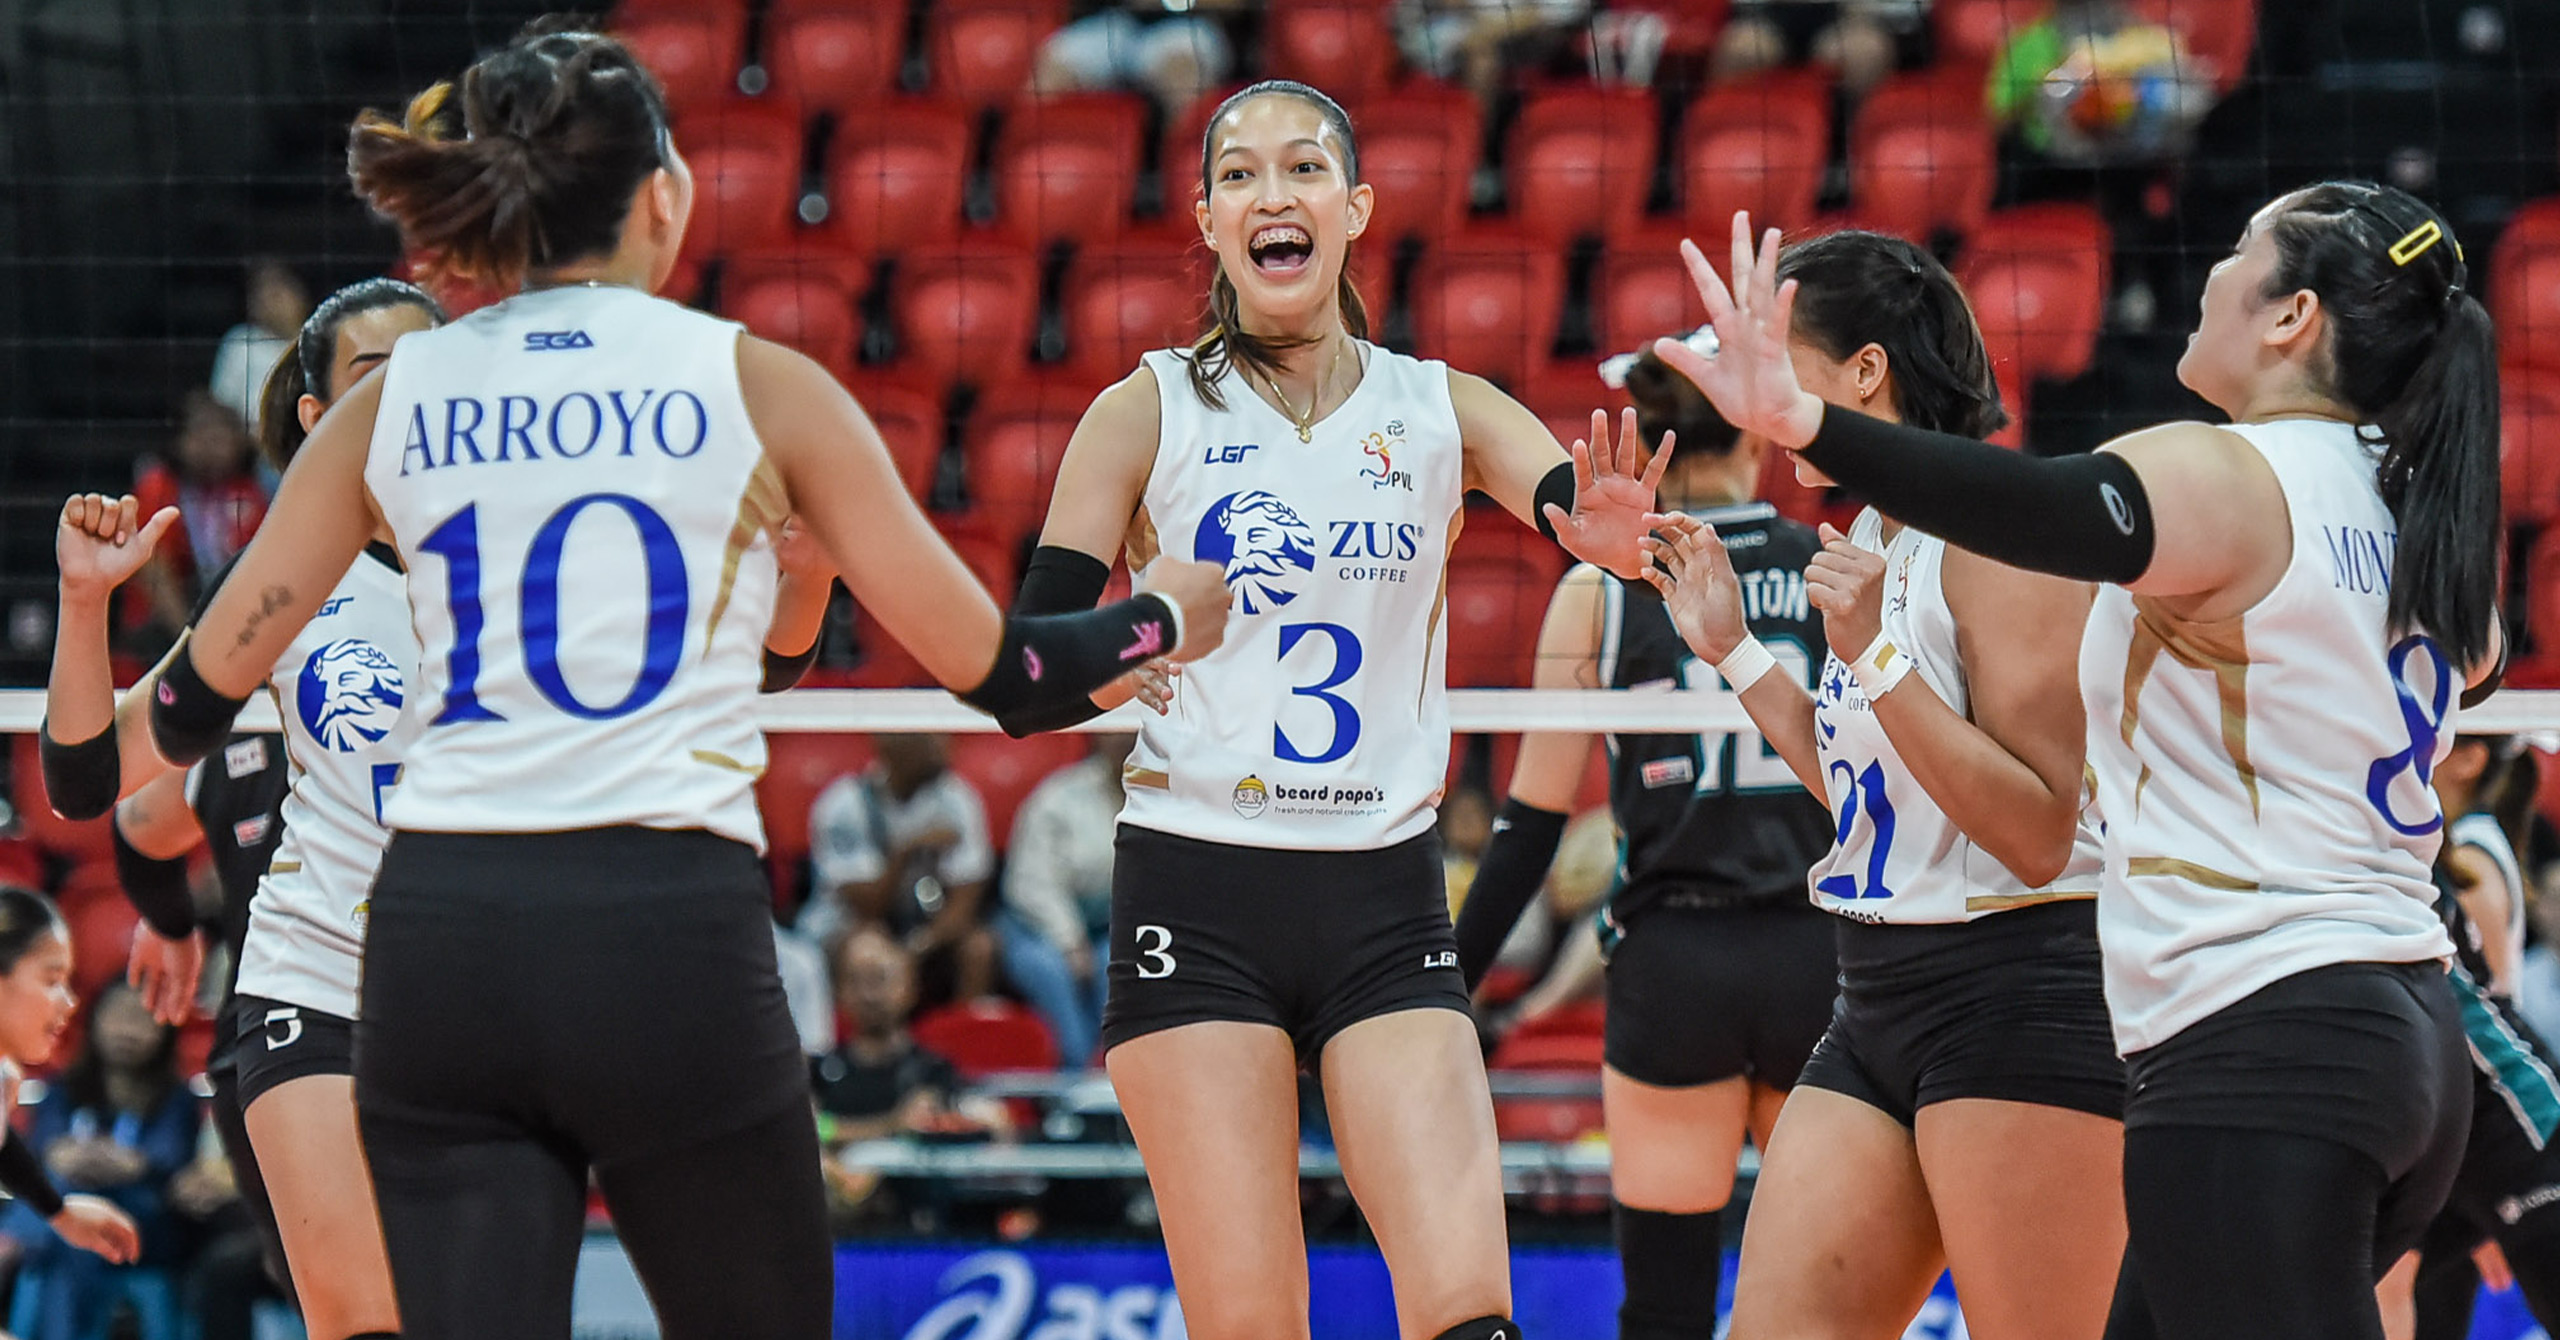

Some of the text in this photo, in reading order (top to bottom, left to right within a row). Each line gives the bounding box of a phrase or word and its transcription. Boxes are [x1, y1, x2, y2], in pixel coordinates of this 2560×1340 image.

[399, 389, 708, 477] ARROYO
[1391, 471, 1414, 492] PVL
[1338, 566, 1408, 583] COFFEE
[2322, 524, 2398, 596] MON
[416, 492, 690, 727] 10
[1273, 622, 1364, 764] 3
[2366, 633, 2451, 837] 8
[1274, 806, 1297, 814] fresh
[1298, 807, 1314, 815] and
[1315, 807, 1343, 815] natural
[1275, 784, 1385, 805] beard papa's
[1815, 756, 1897, 900] 21
[1135, 925, 1177, 979] 3
[263, 1006, 303, 1052] 5
